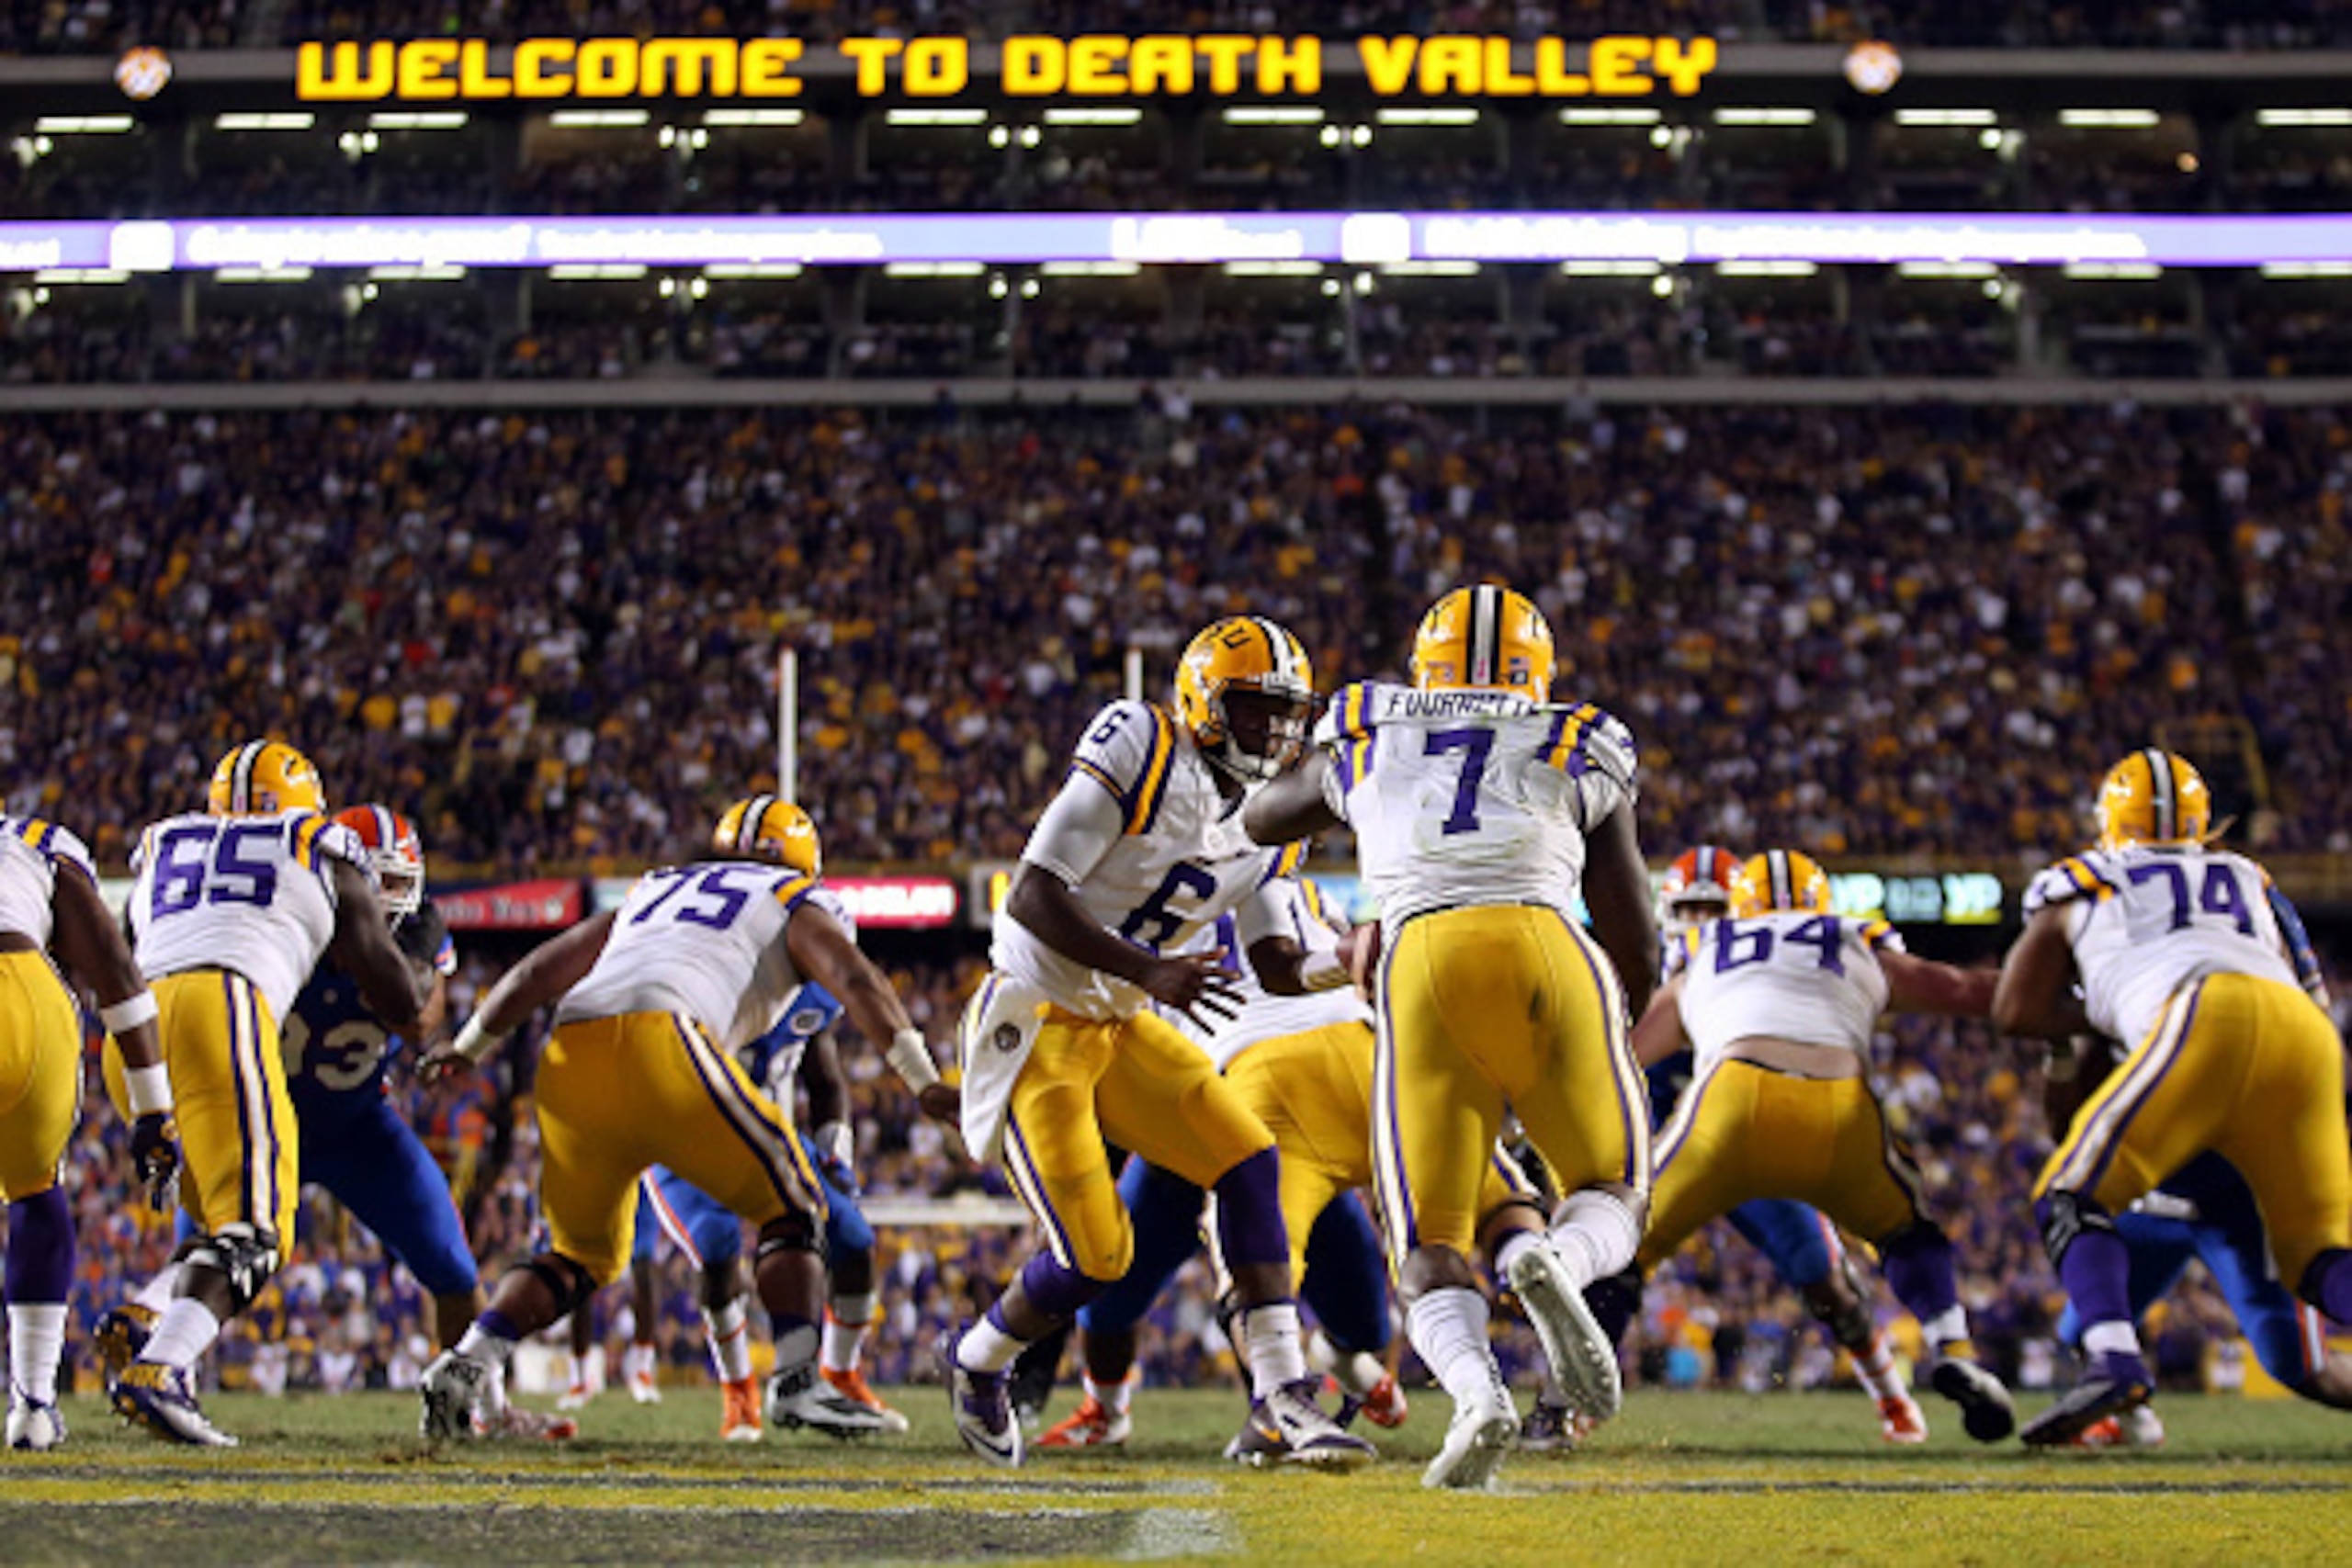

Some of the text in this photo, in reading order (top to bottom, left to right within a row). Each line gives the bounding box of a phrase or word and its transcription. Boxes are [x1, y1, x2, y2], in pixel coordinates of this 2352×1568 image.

[297, 36, 1717, 99] WELCOME TO DEATH VALLEY
[1091, 708, 1129, 745] 6
[1422, 728, 1497, 834] 7
[151, 825, 286, 922] 65
[629, 868, 750, 930] 75
[2124, 863, 2257, 937] 74
[1119, 861, 1218, 957] 6
[1714, 915, 1845, 977] 64
